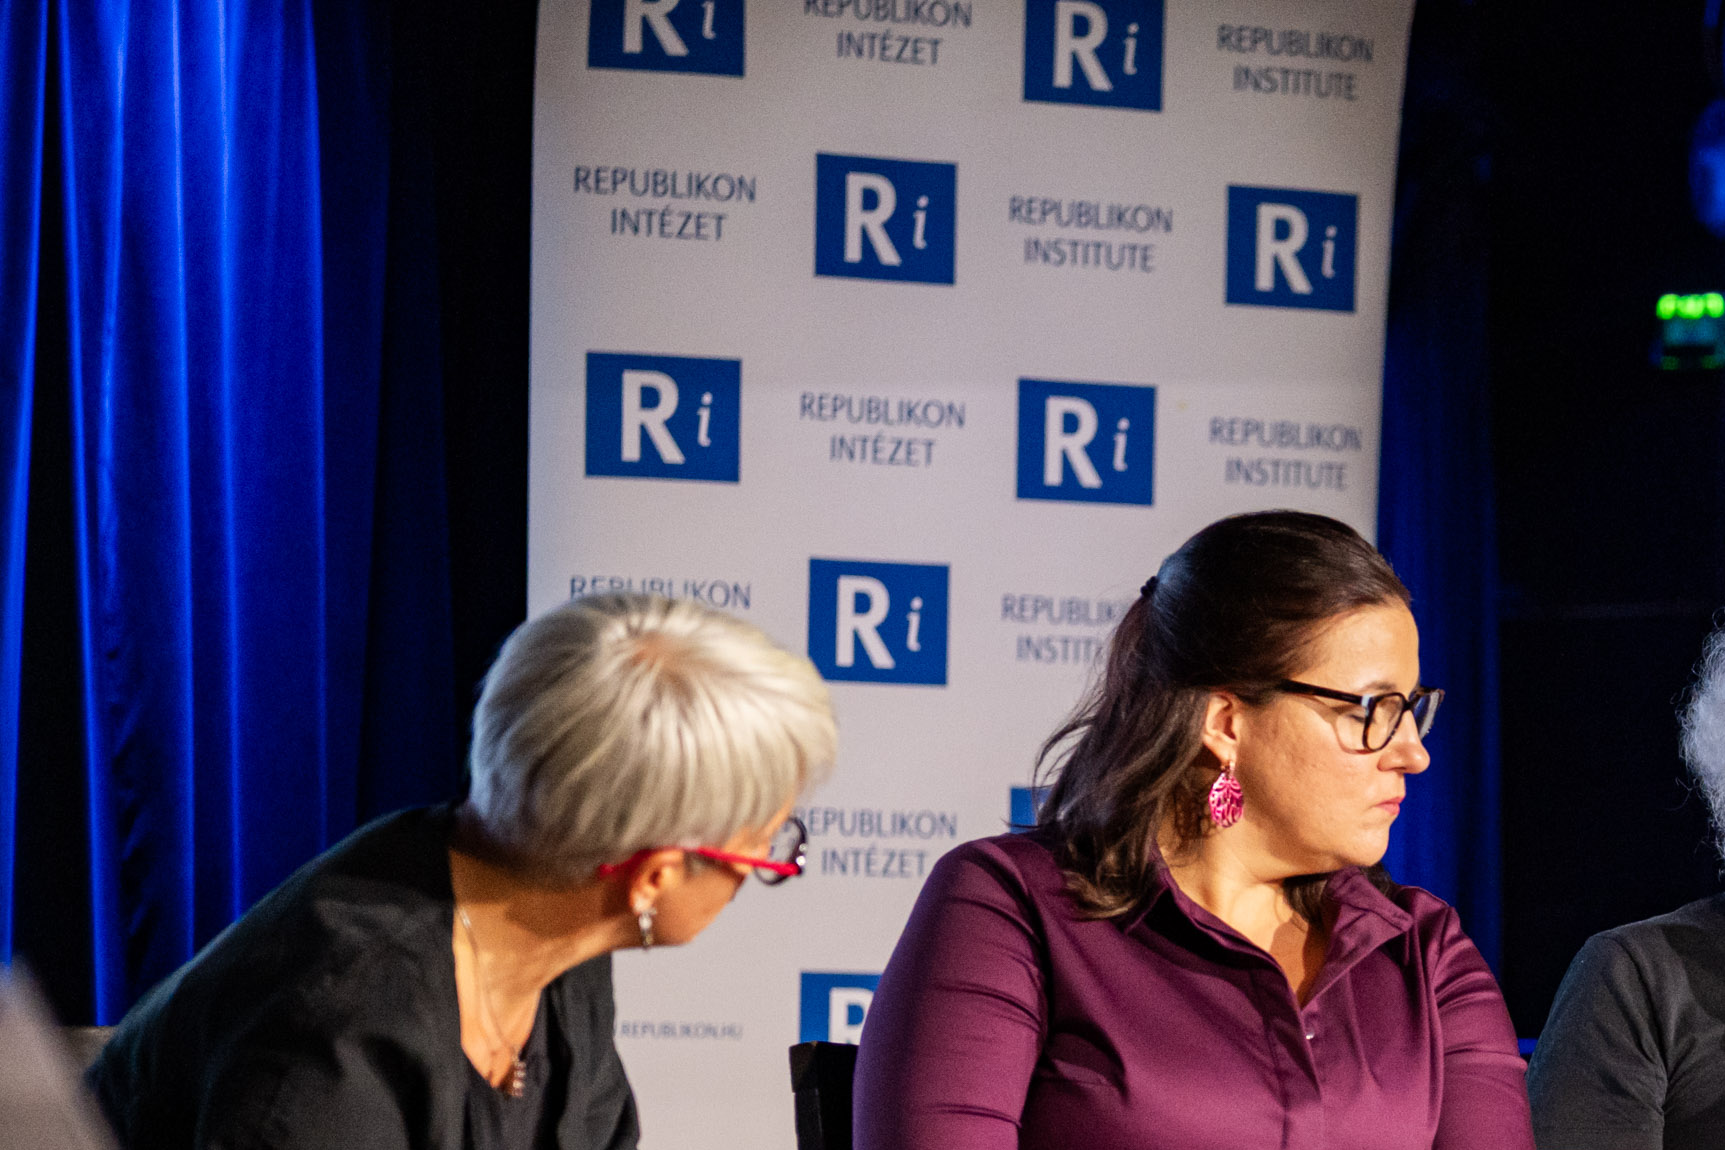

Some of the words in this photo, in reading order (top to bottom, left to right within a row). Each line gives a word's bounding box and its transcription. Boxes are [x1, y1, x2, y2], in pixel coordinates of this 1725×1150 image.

[836, 29, 944, 66] INTÉZET
[1216, 23, 1375, 62] REPUBLIKON
[1232, 65, 1358, 101] INSTITUTE
[573, 165, 757, 203] REPUBLIKON
[610, 206, 728, 242] INTÉZET
[1008, 195, 1174, 233] REPUBLIKON
[1023, 236, 1156, 273] INSTITUTE
[800, 391, 967, 428] REPUBLIKON
[829, 433, 937, 468] INTÉZET
[1208, 416, 1363, 451] REPUBLIKON
[1224, 456, 1349, 491] INSTITUTE
[821, 842, 928, 878] INTÉZET
